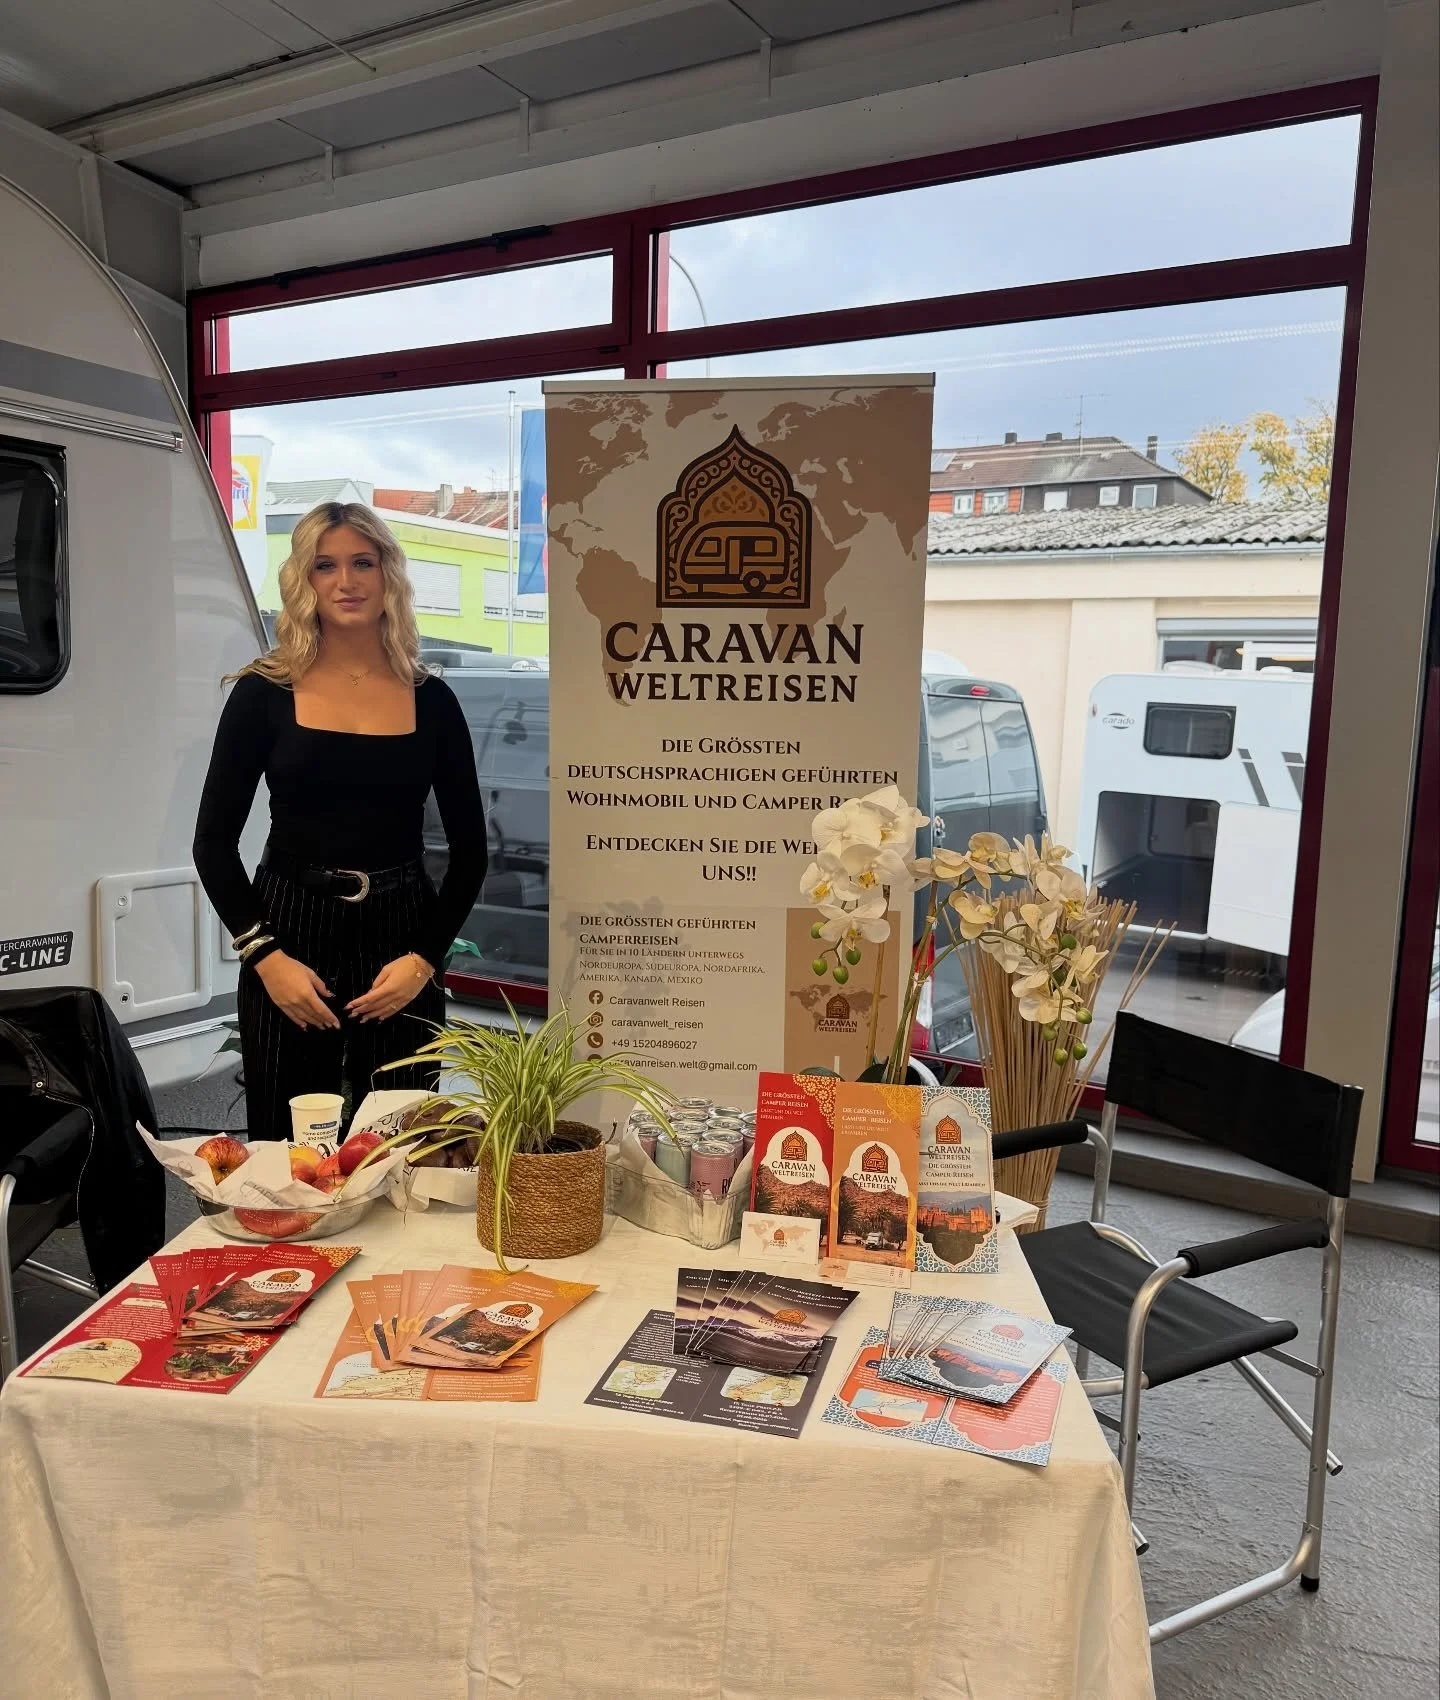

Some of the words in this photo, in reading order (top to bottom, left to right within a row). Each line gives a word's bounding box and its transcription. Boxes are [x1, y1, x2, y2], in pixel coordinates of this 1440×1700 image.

[605, 621, 864, 665] CARAVAN
[607, 672, 858, 703] WELTREISEN
[661, 738, 693, 753] DIE
[698, 737, 801, 755] GRÖSSTEN
[567, 764, 776, 783] DEUTSCHSPRACHIGEN
[782, 765, 898, 785] GEFÜHRTEN
[566, 790, 689, 809] WOHNMOBIL
[694, 794, 737, 810] UND
[742, 792, 823, 811] CAMPER
[586, 834, 704, 853] ENTDECKEN
[709, 837, 739, 854] SIE
[744, 839, 777, 854] DIE
[701, 865, 757, 882] UNS!!
[580, 915, 602, 926] DIE
[604, 915, 673, 928] GRÖSSTEN
[677, 917, 756, 930] GEFÜHRTEN
[579, 933, 679, 946] CAMPERREISEN
[0, 945, 66, 972] C-LINE
[580, 946, 598, 956] FÜR
[599, 947, 615, 956] SIE
[616, 948, 627, 957] IN
[629, 948, 639, 957] 10
[641, 946, 686, 958] LÄNDERN
[688, 949, 745, 960] UNTERWEGS
[667, 975, 703, 985] MEXIKO
[609, 995, 669, 1008] Caravanwelt
[672, 996, 705, 1008] Reisen
[611, 1017, 704, 1030] caravanwelt_reisen
[818, 1019, 858, 1028] CARAVAN
[611, 1038, 630, 1049] +49
[632, 1038, 698, 1050] 15204896027
[927, 1145, 971, 1154] CARAVAN
[771, 1161, 816, 1172] CARAVAN
[772, 1169, 815, 1179] WELTREISEN
[852, 1172, 898, 1185] CARAVAN
[853, 1180, 897, 1191] WELTREISEN
[251, 1280, 302, 1289] CARAVAN
[485, 1310, 531, 1325] CARAVAN
